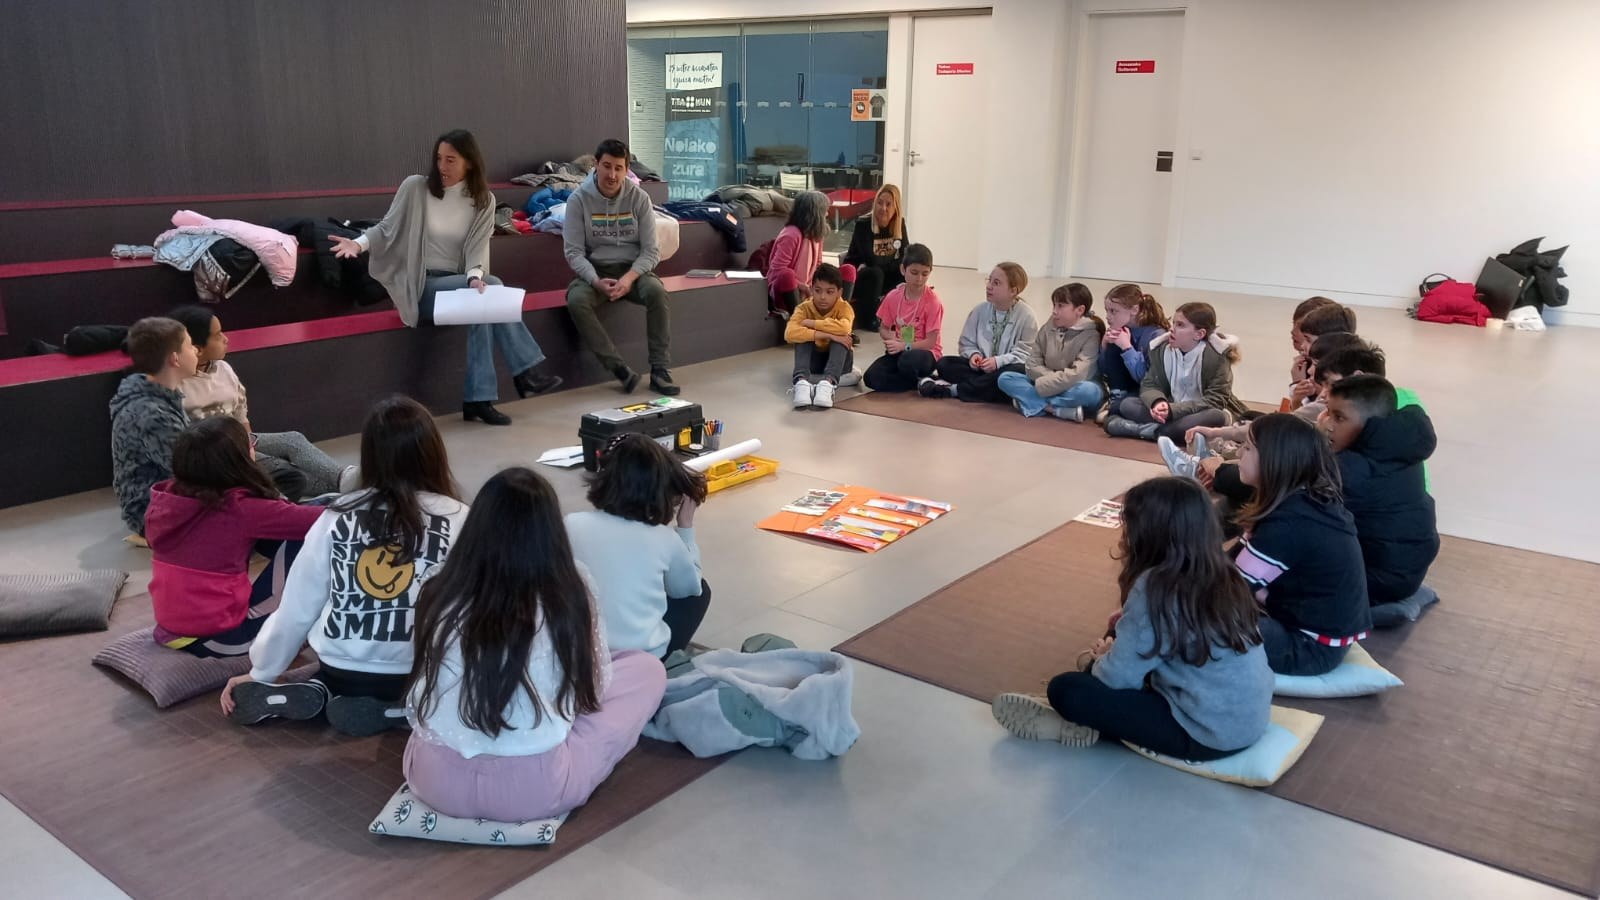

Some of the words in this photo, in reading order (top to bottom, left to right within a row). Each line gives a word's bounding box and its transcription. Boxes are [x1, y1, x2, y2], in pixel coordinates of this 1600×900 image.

[665, 138, 716, 153] Nolako
[672, 164, 705, 176] zura
[593, 229, 635, 237] patagnia
[331, 591, 416, 612] SMIL
[324, 608, 414, 642] SMIL
